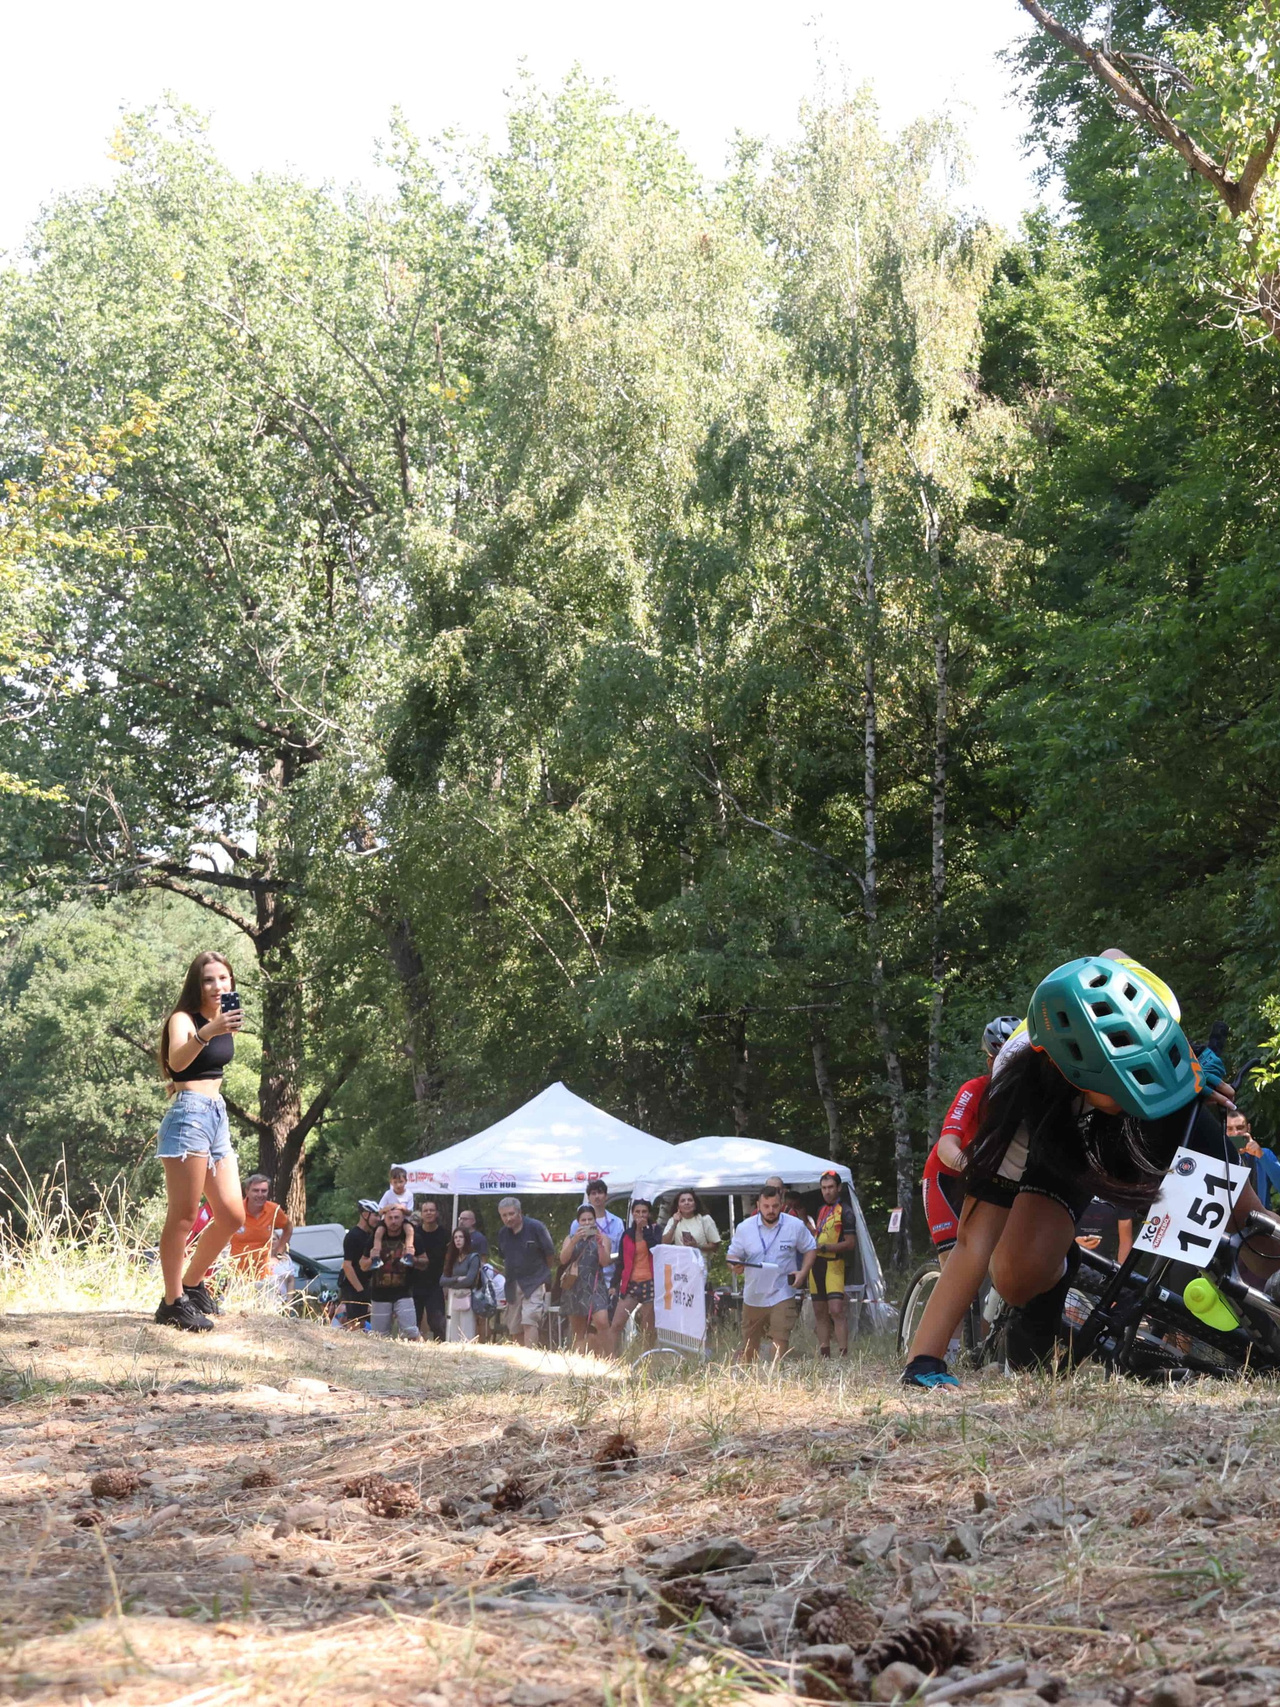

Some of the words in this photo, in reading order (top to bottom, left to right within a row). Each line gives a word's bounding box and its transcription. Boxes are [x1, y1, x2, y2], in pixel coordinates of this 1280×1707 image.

[479, 1181, 499, 1189] BIKE
[499, 1180, 517, 1189] HUB
[1176, 1172, 1239, 1253] 151
